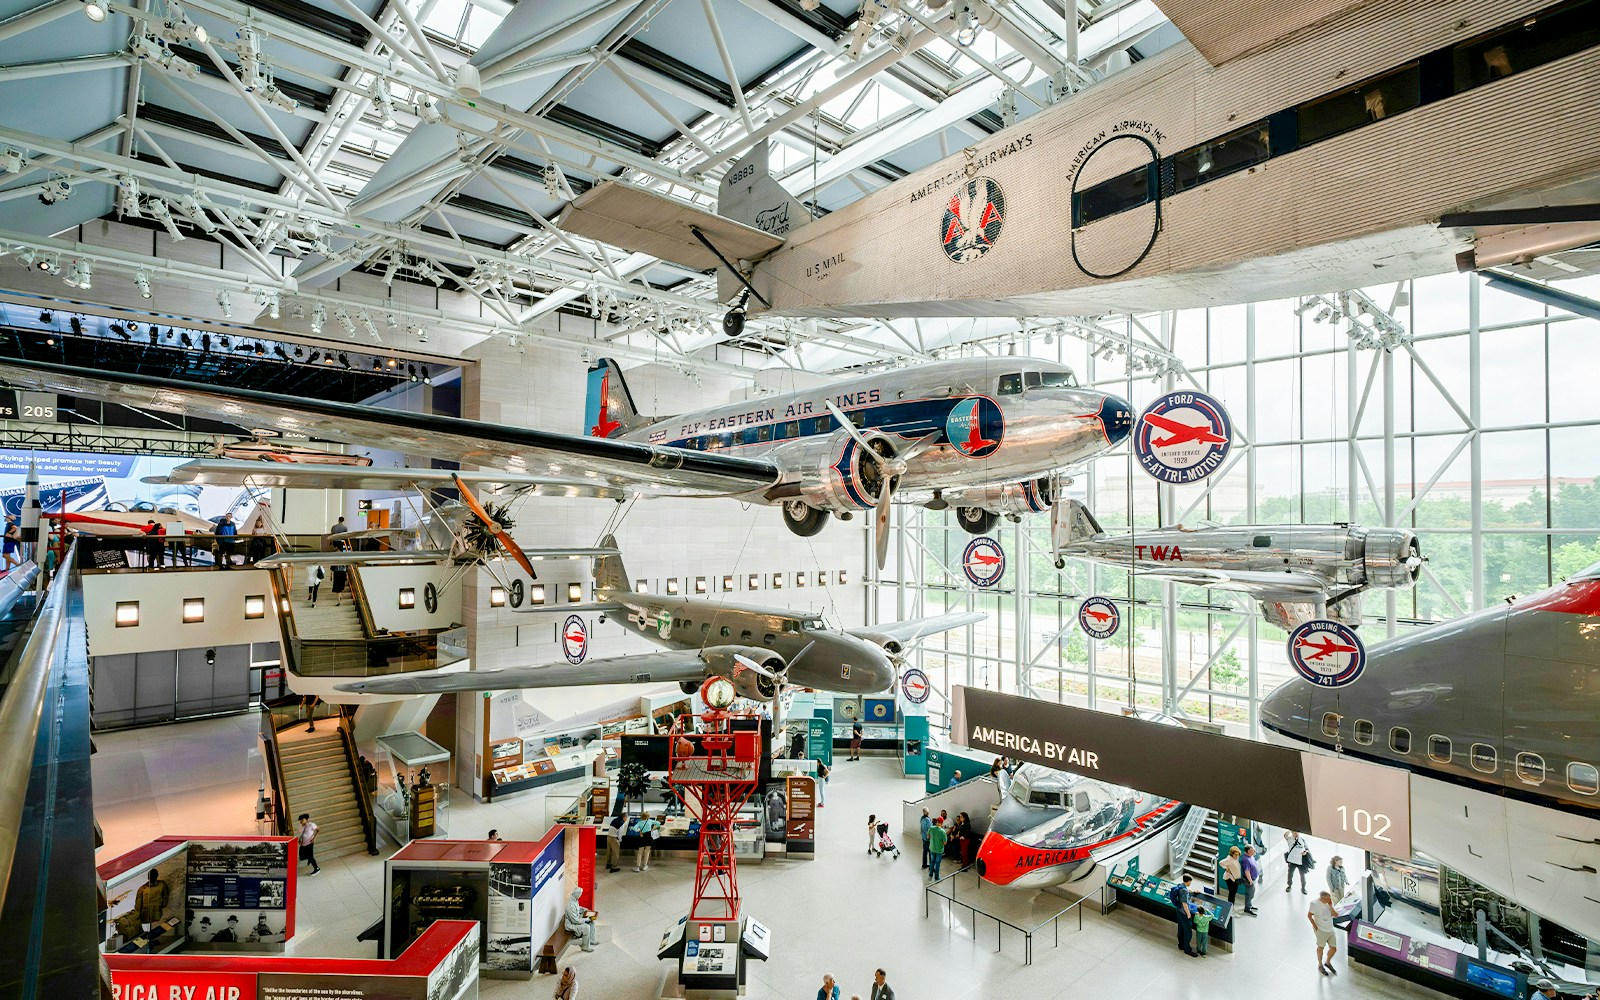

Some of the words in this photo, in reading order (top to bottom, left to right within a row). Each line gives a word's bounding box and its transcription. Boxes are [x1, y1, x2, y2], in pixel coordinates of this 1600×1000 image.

[976, 134, 1032, 170] AIRWAYS
[1066, 130, 1106, 181] AMERICAN
[1112, 120, 1152, 133] AIRWAYS
[1152, 128, 1166, 144] INC
[728, 164, 754, 187] N9683
[755, 201, 790, 231] Ford
[770, 223, 790, 236] OTOR
[822, 252, 846, 270] MAIL
[1169, 394, 1193, 406] FORD
[24, 406, 53, 418] 205
[785, 401, 813, 417] AIR
[950, 415, 977, 423] EASTERN
[1143, 454, 1165, 476] 5-AT
[1164, 451, 1222, 482] TRI-MOTOR
[1135, 545, 1183, 562] TWA
[1311, 623, 1338, 632] BOEING
[1318, 676, 1332, 685] 747
[972, 725, 1042, 756] AMERICA
[1044, 741, 1067, 761] BY
[1068, 748, 1099, 770] AIR
[1337, 805, 1392, 842] 102
[1016, 849, 1078, 868] AMERICAN
[170, 985, 196, 1000] BY
[206, 986, 240, 1000] AIR
